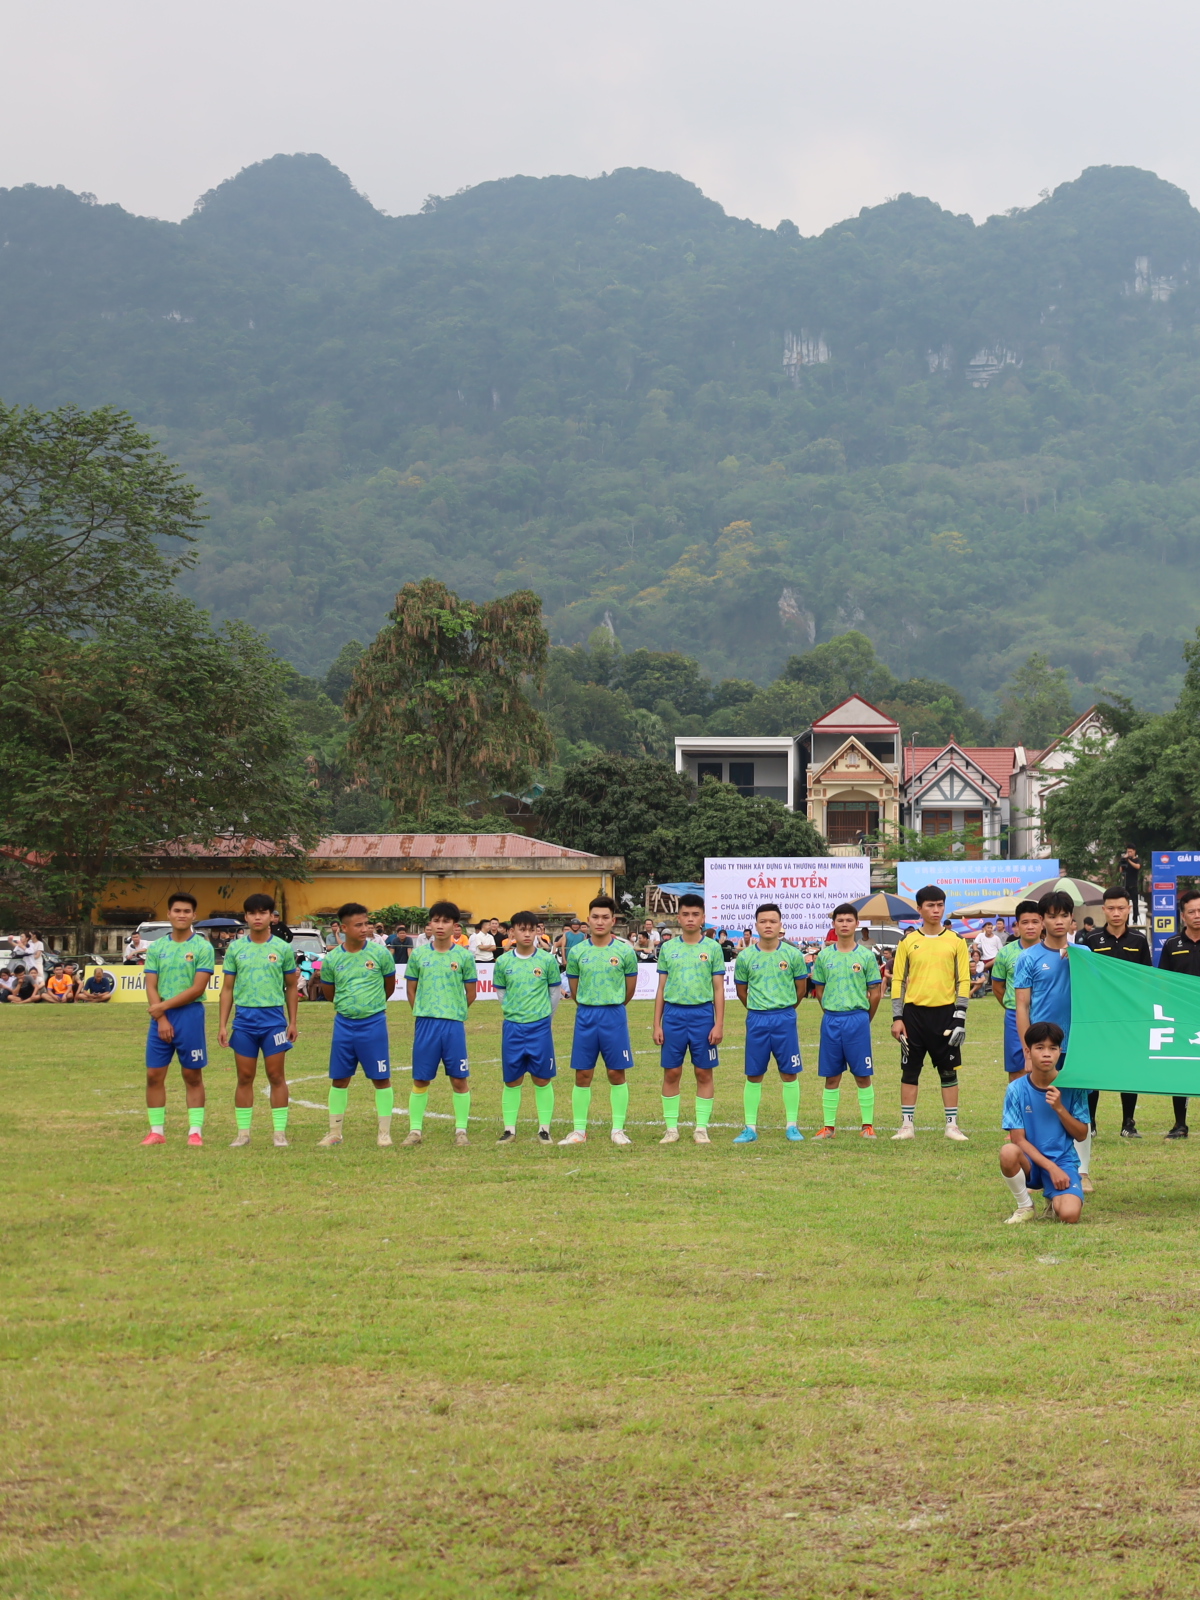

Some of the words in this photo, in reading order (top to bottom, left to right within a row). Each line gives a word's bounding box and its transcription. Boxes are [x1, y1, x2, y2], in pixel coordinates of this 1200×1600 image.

[710, 862, 726, 870] CÔNG
[753, 862, 765, 870] XÂY
[817, 863, 829, 871] MẠI
[747, 871, 777, 889] CẦN
[780, 870, 828, 889] TUYỂN
[734, 893, 748, 901] THỢ
[749, 892, 759, 900] VÀ
[760, 893, 774, 901] PHỤ
[828, 891, 849, 899] NHÔM
[850, 891, 866, 899] KÍNH
[741, 901, 754, 910] BIẾT
[784, 902, 804, 911] ĐƯỢC
[806, 901, 821, 909] ĐÀO
[822, 902, 836, 911] TẠO
[720, 912, 736, 920] MỨC
[782, 921, 798, 930] ÓNG
[800, 921, 814, 930] BẢO
[1157, 919, 1171, 929] GP
[191, 1048, 204, 1062] 94
[622, 1050, 630, 1062] 4
[708, 1047, 717, 1061] 10
[377, 1059, 387, 1073] 16
[549, 1058, 554, 1071] 7
[865, 1056, 872, 1069] 9
